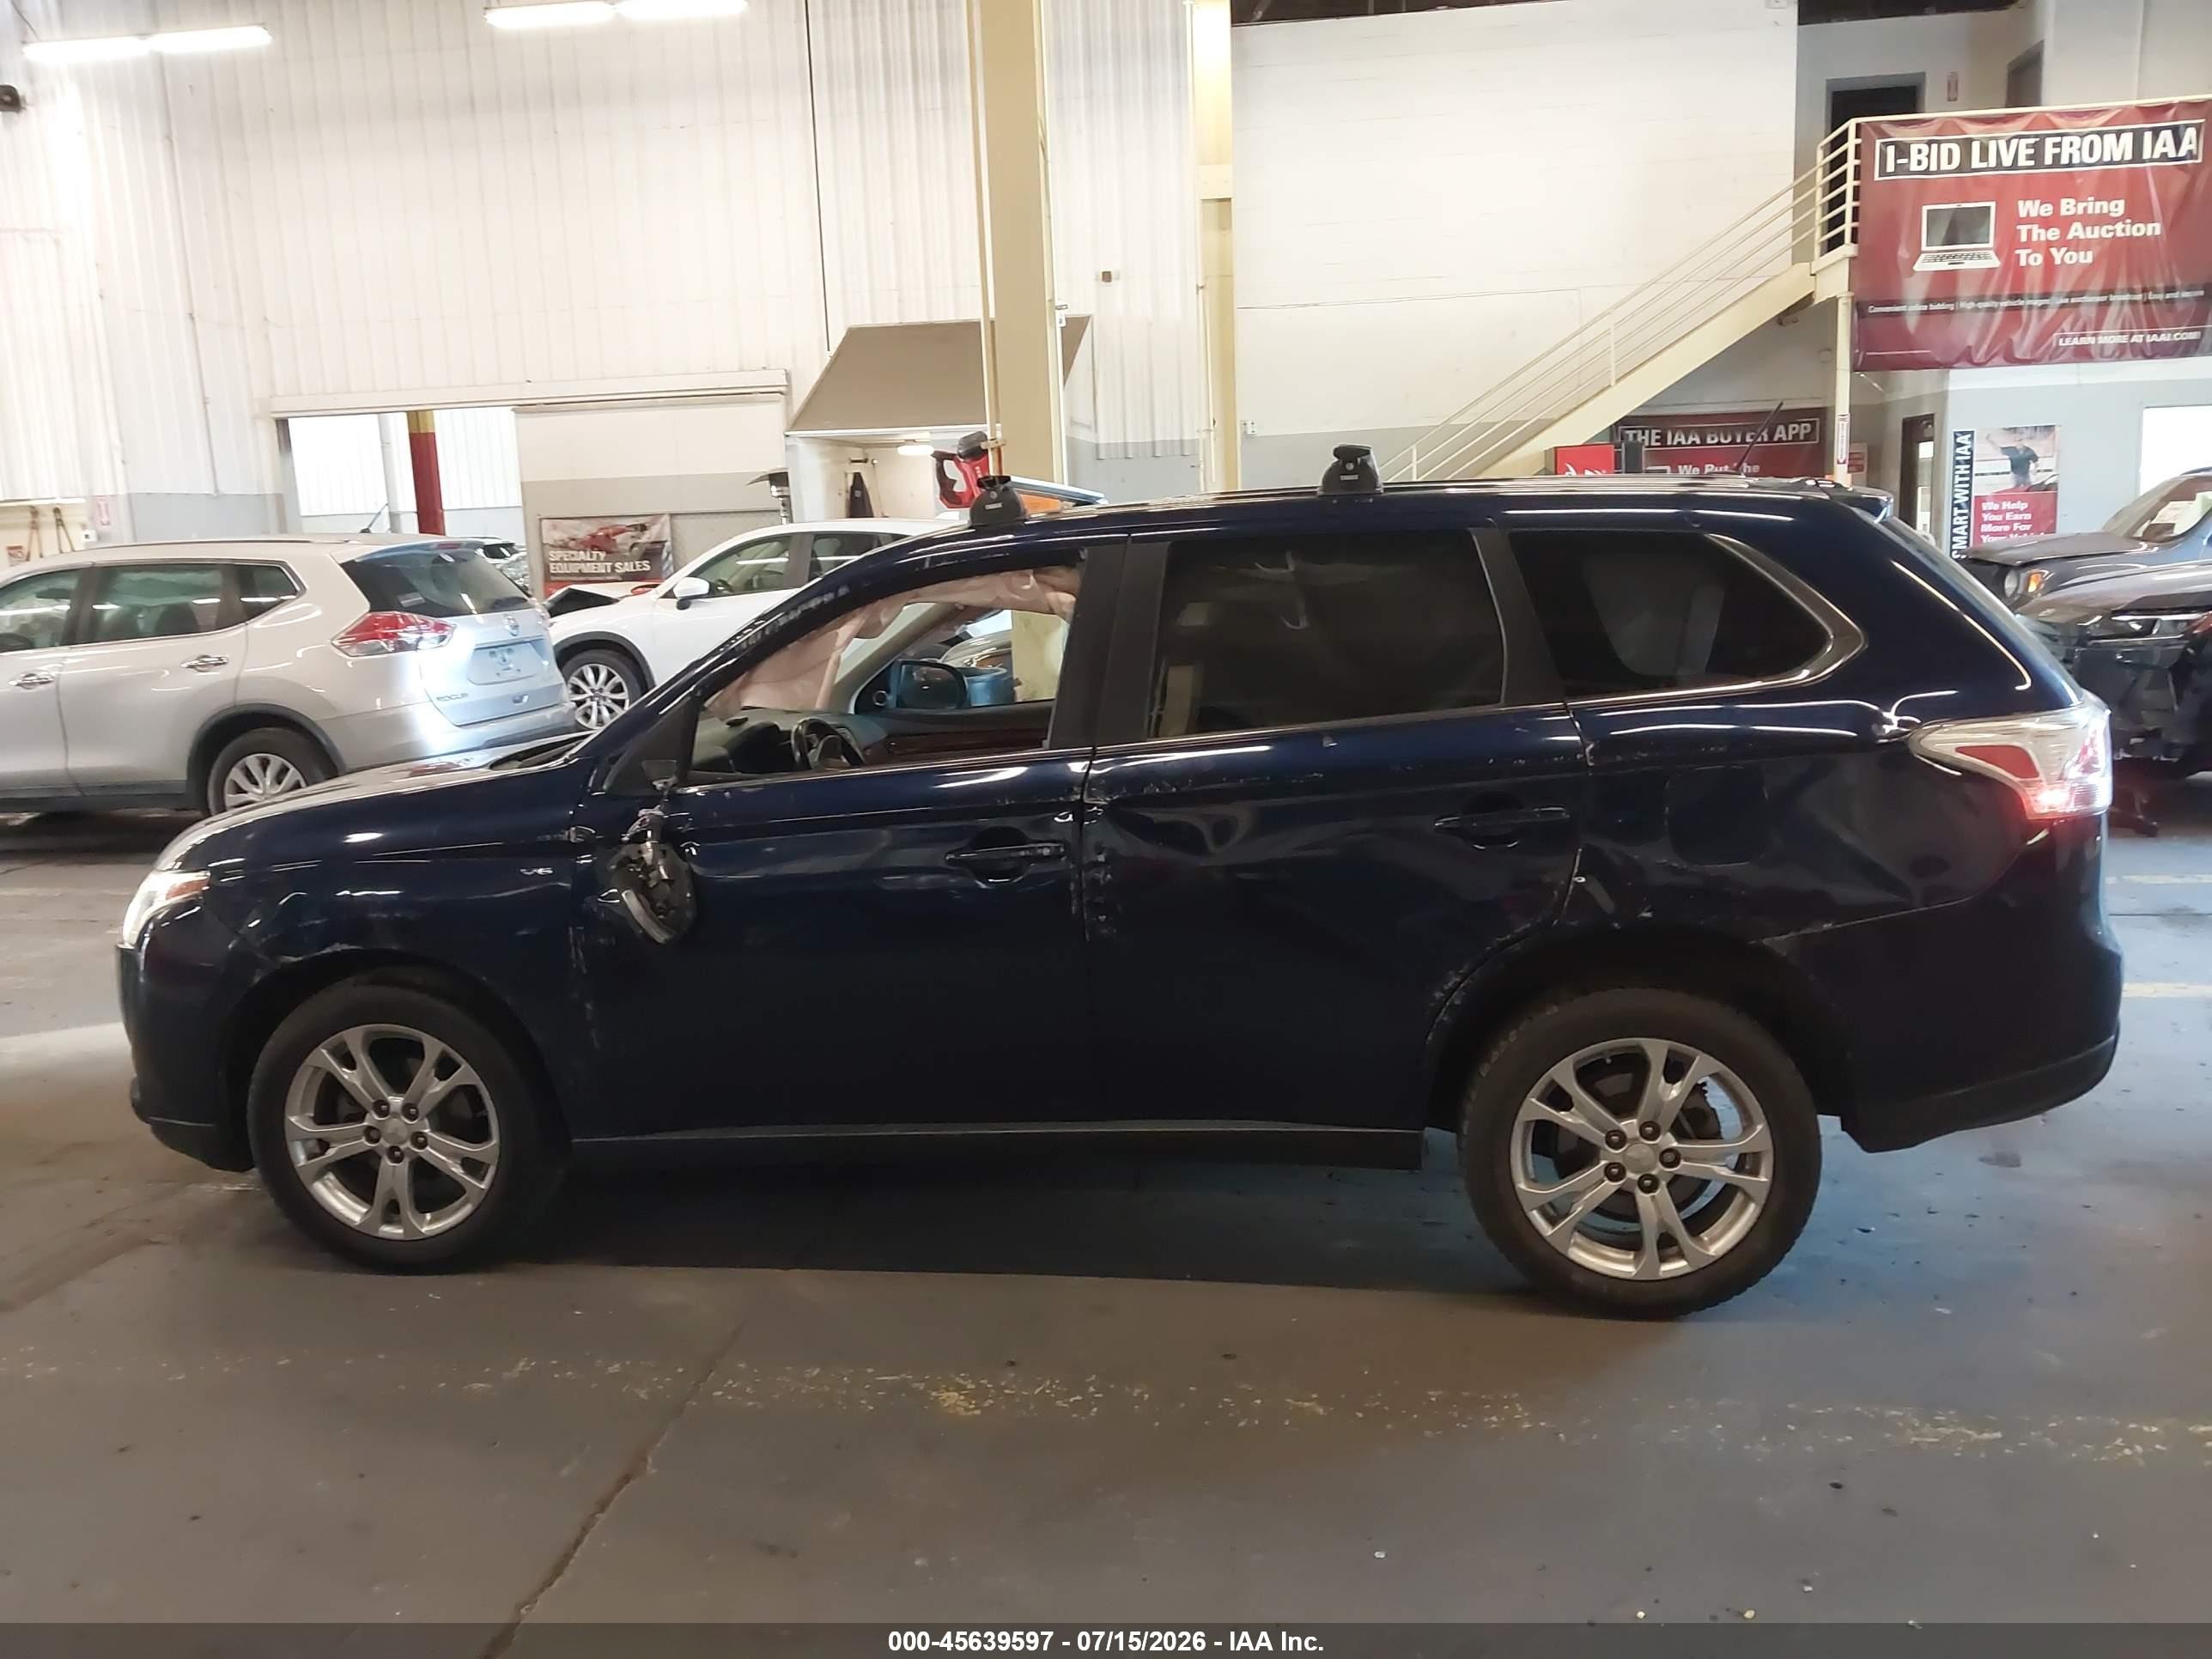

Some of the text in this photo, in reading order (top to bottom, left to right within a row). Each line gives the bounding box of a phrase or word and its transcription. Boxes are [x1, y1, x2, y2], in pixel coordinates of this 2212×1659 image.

[1886, 127, 2197, 172] I-BID LIVE FROM IAA
[2018, 197, 2125, 218] We Bring
[2016, 219, 2161, 242] The Auction
[2014, 247, 2094, 267] To You
[2130, 333, 2145, 343] AT
[1625, 423, 1812, 446] THE IAA BUYER APP
[1955, 434, 1972, 460] IAA
[1678, 465, 1700, 475] We
[1952, 464, 1971, 504] WITH
[1981, 501, 2028, 511] We Help
[1982, 512, 2032, 521] You Earn
[1980, 522, 2033, 532] More For
[549, 550, 606, 562] SPECIALTY
[550, 560, 652, 574] EQUIPMENT SALES
